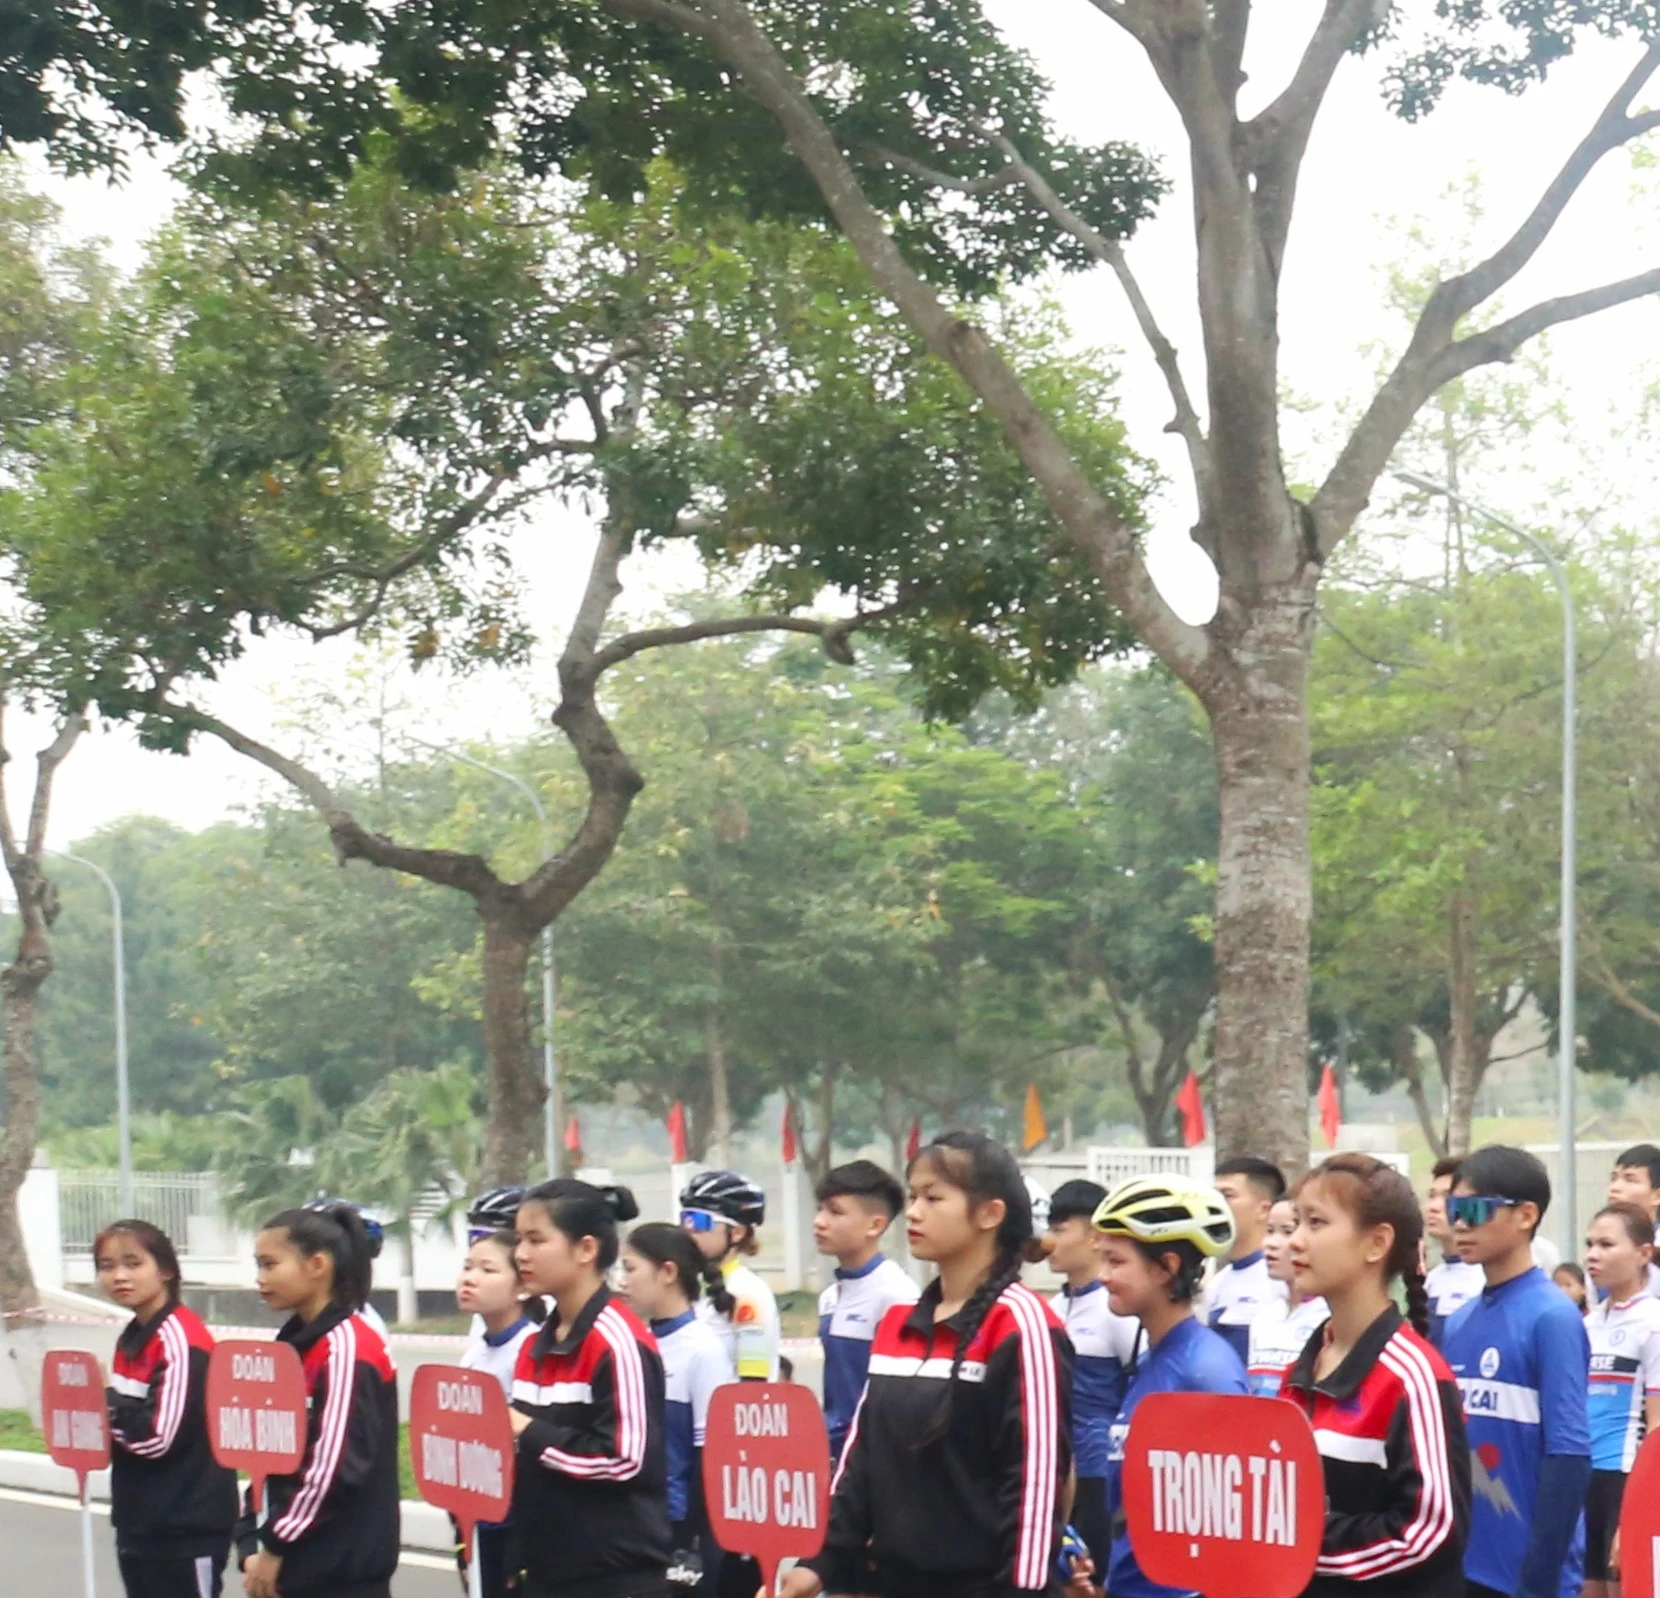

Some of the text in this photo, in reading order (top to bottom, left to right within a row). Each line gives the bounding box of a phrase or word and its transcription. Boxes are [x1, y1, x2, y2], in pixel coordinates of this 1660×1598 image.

[721, 1449, 817, 1530] LÀO CAI
[1147, 1438, 1297, 1559] TRỌNG TÀI
